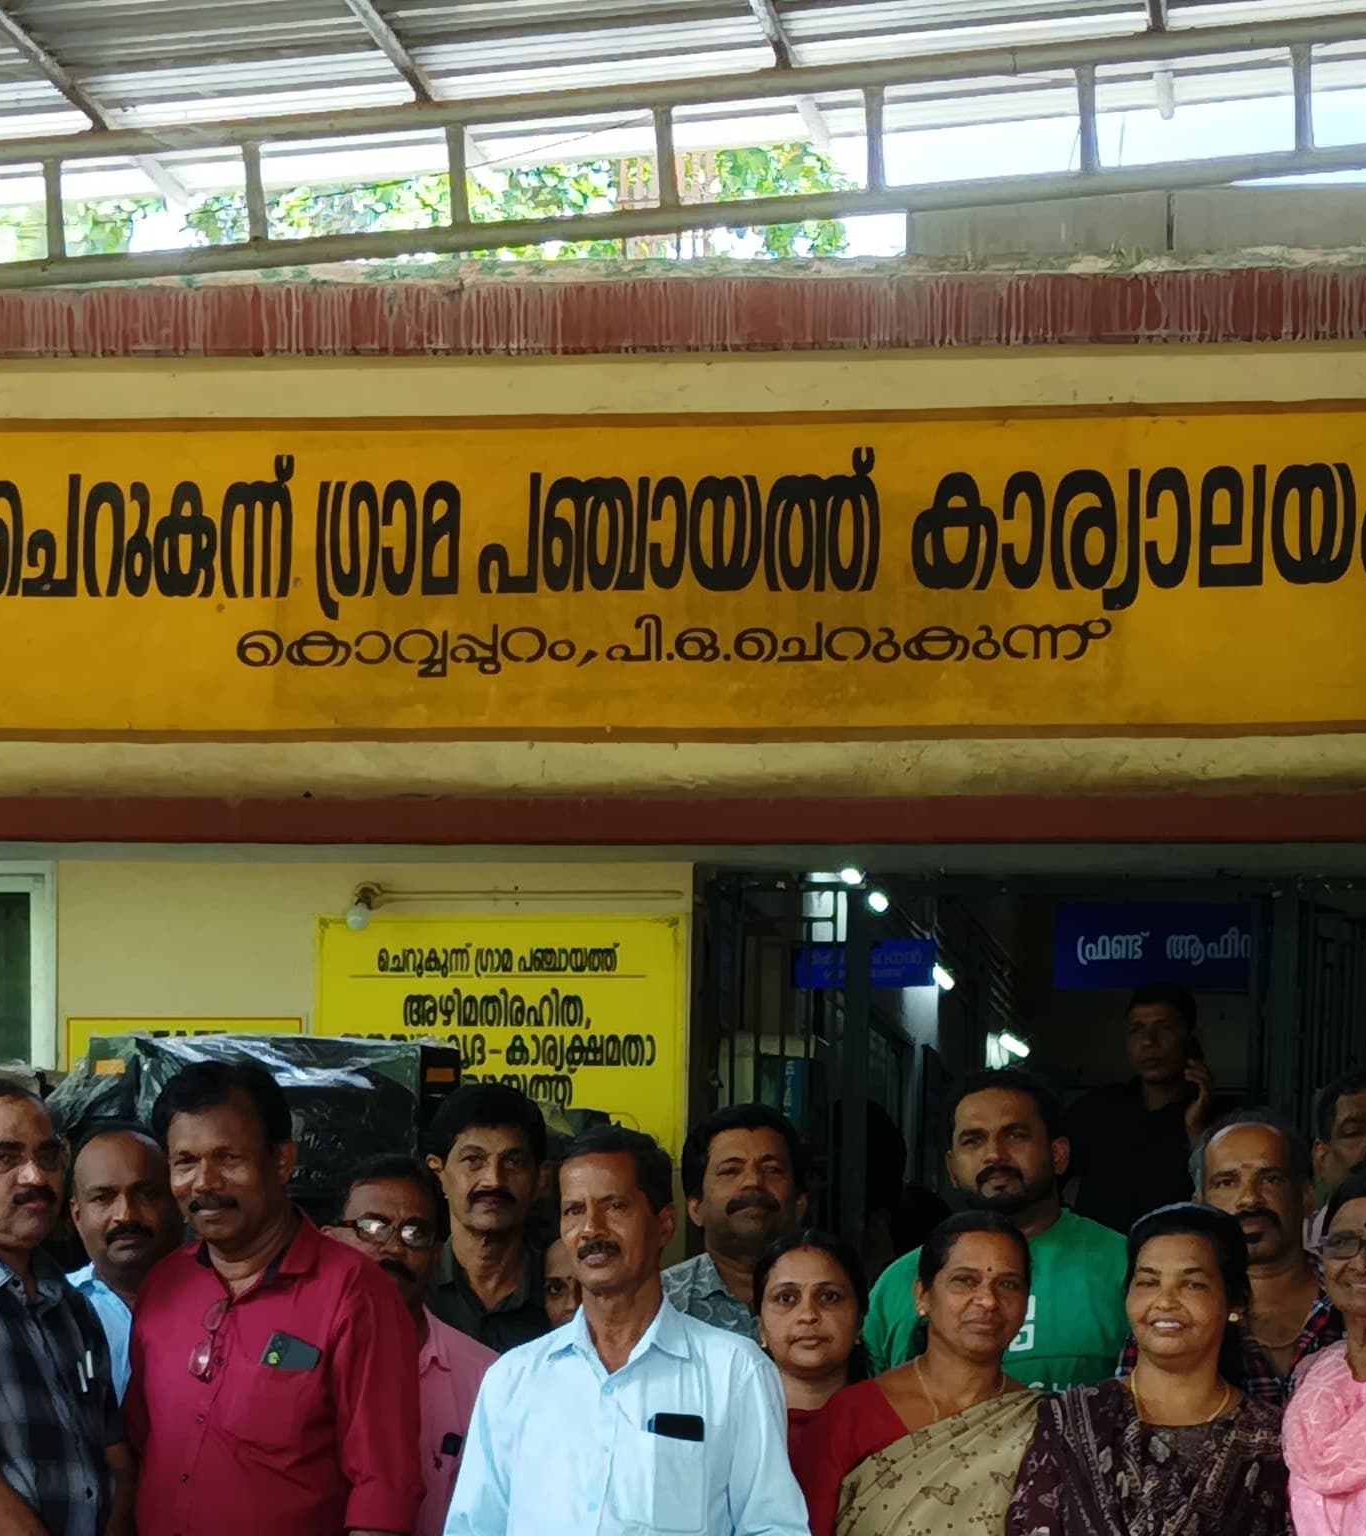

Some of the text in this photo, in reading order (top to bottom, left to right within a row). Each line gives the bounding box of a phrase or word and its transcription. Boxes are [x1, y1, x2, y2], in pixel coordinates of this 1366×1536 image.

[316, 478, 462, 620] ഗ്രാമ
[477, 446, 881, 594] പഞ്ചായത്ത്
[377, 941, 620, 979] ചെറുകുന്ന് ഗ്രാമ പഞ്ചായത്ത്
[403, 987, 592, 1030] അഴിമതിരഹിത,
